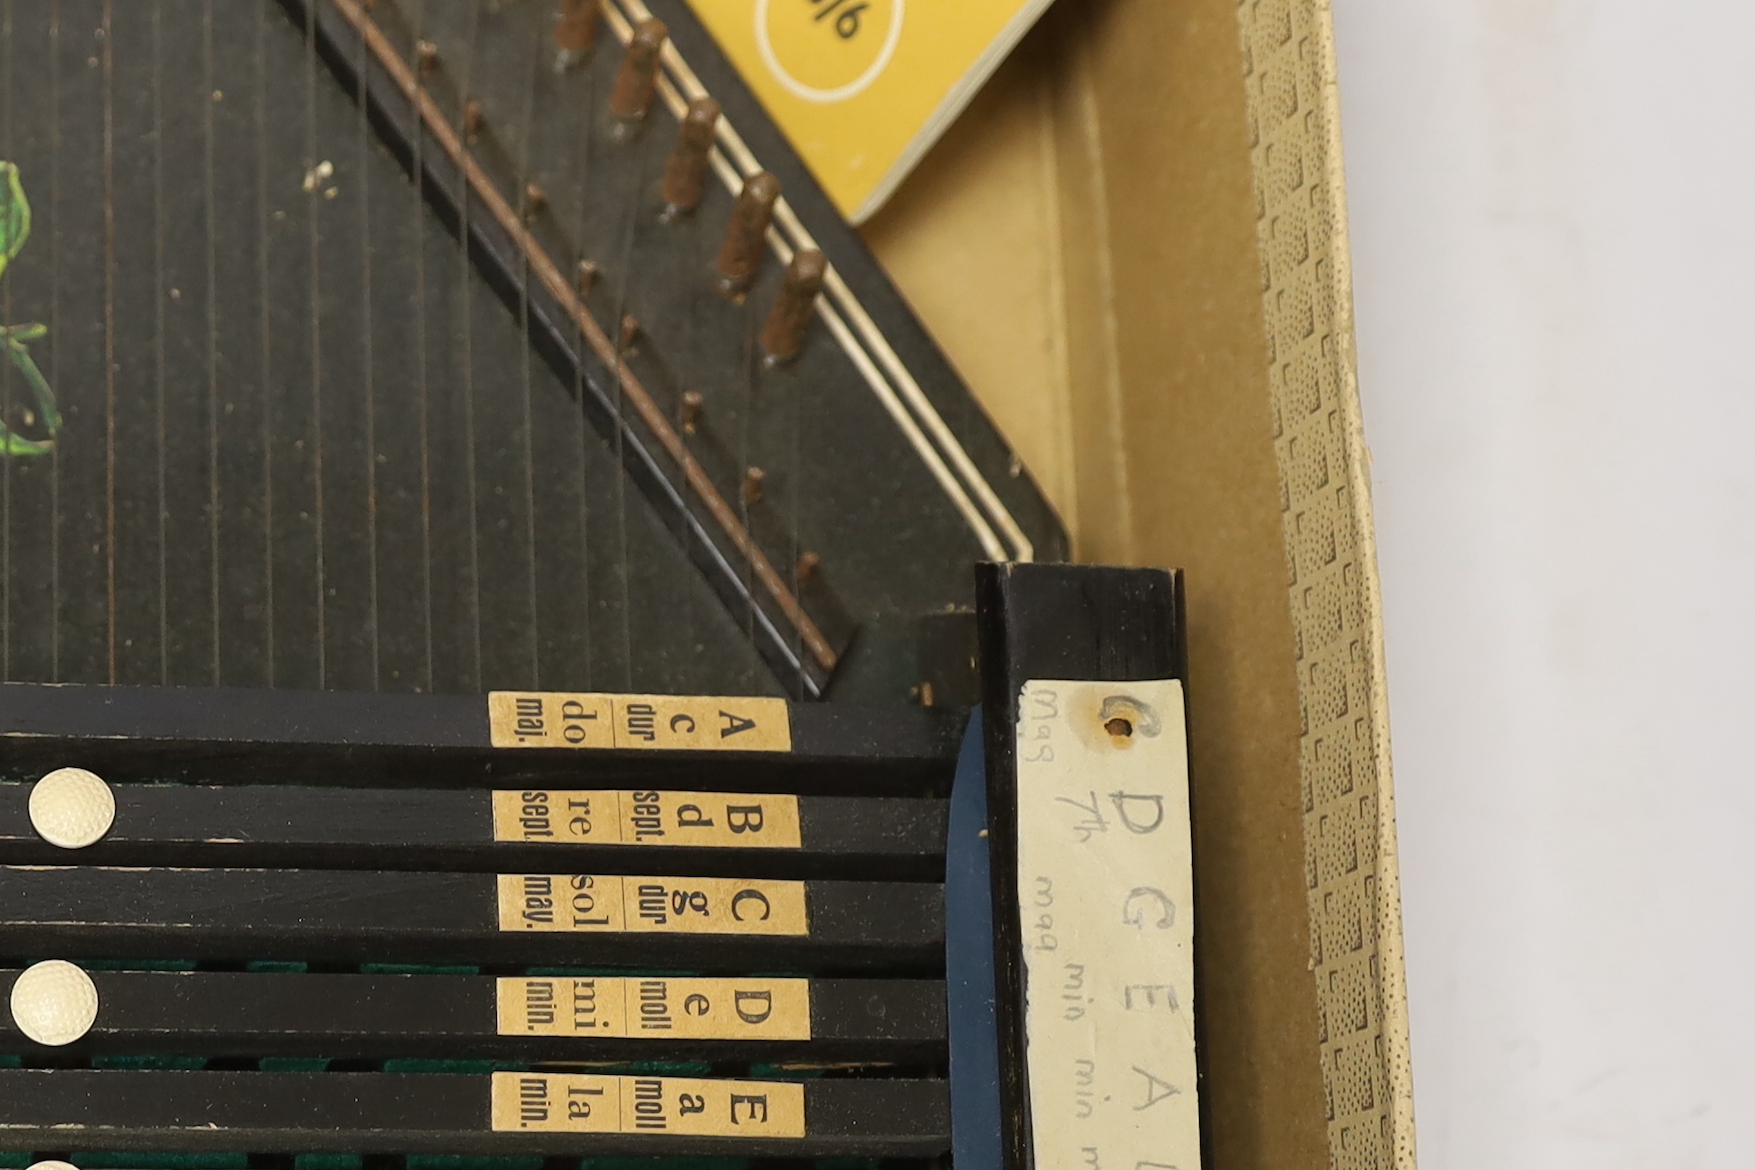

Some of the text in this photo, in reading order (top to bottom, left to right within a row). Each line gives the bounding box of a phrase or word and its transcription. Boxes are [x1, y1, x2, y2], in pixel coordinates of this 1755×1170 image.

[513, 699, 547, 742] maj.
[562, 700, 597, 745] do
[626, 704, 656, 741] dur
[670, 714, 696, 734] c
[718, 710, 757, 739] A
[567, 798, 592, 835] re
[633, 791, 665, 842] sept.
[677, 804, 713, 827] d
[727, 803, 764, 834] B
[1055, 791, 1110, 843] 7th
[1109, 790, 1164, 834] D
[524, 876, 554, 929] may.
[571, 875, 609, 928] sol
[638, 885, 667, 925] dur
[672, 889, 711, 917] g
[731, 888, 771, 922] C
[1123, 886, 1176, 929] G
[527, 980, 558, 1031] min.
[573, 979, 610, 1031] mi
[640, 980, 673, 1030] moll
[684, 993, 711, 1017] e
[734, 989, 772, 1025] D
[1064, 963, 1094, 1021] min
[1125, 983, 1179, 1014] E
[520, 1078, 551, 1128] min.
[567, 1085, 604, 1121] la
[634, 1079, 667, 1129] moll
[679, 1094, 705, 1115] a
[730, 1092, 768, 1125] E
[1074, 1060, 1110, 1119] min
[1132, 1065, 1182, 1111] A
